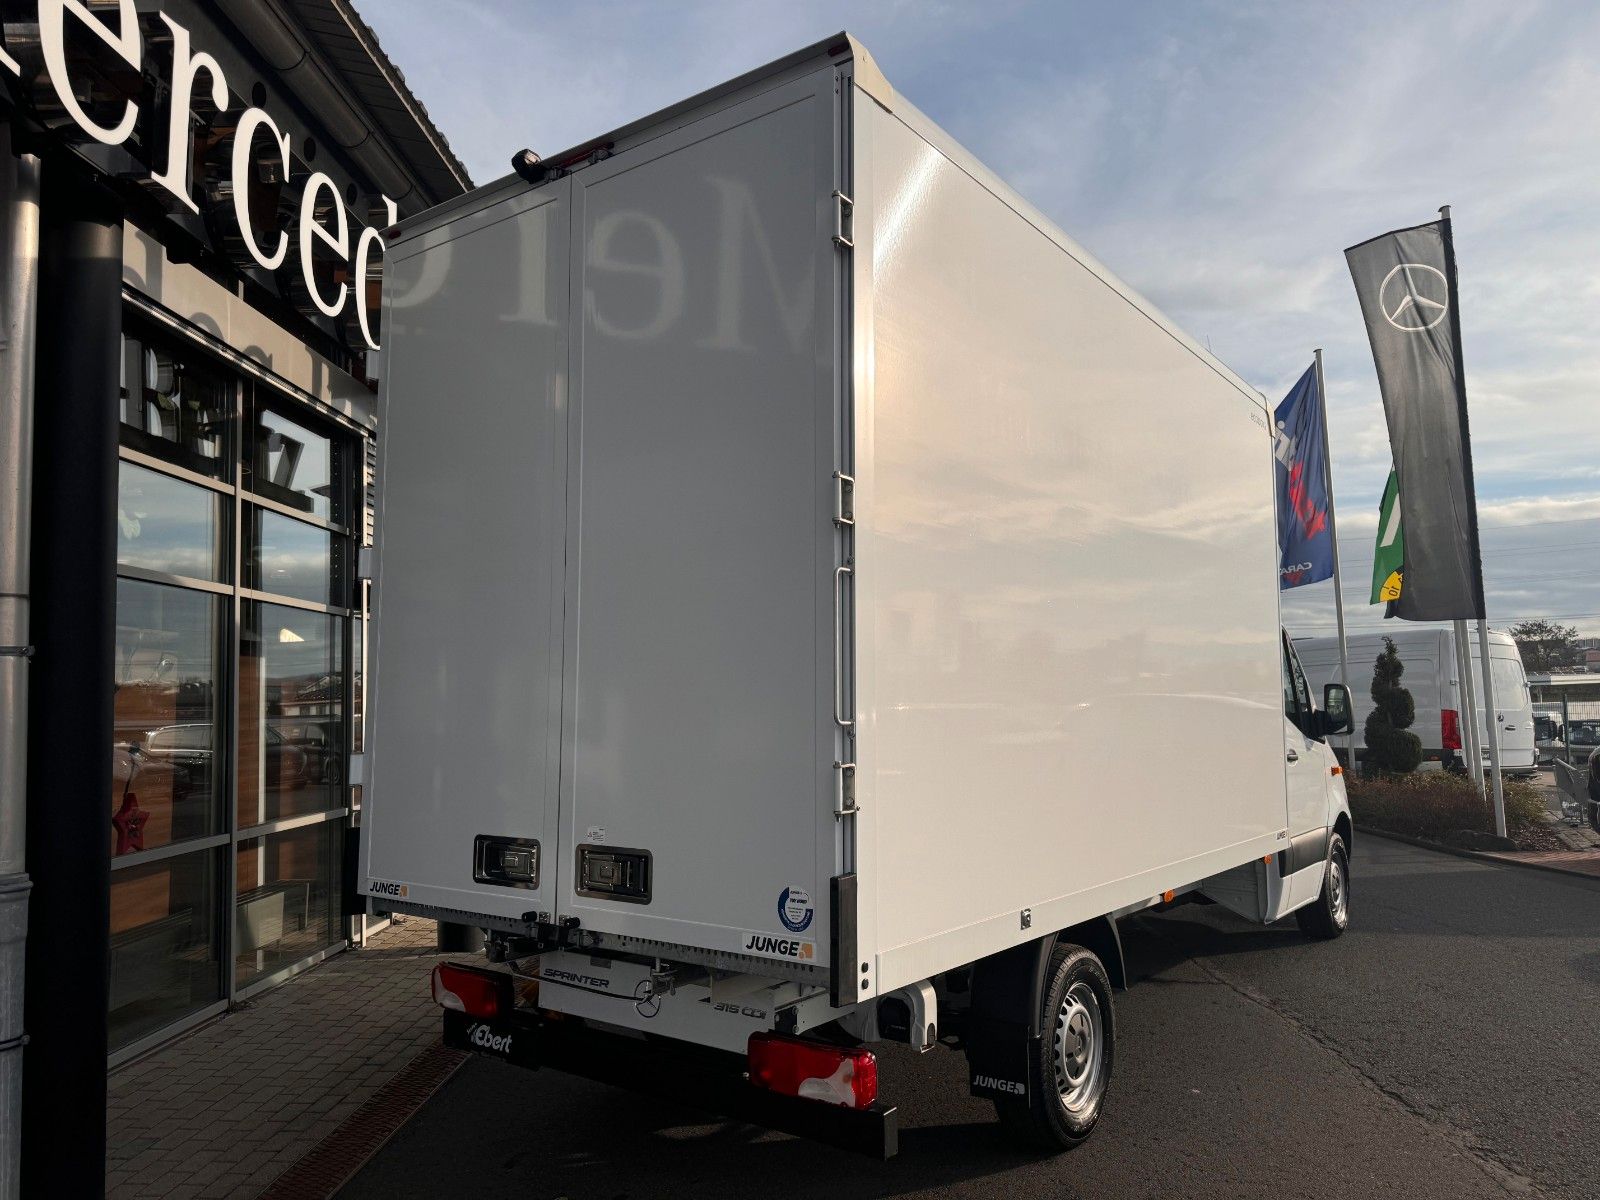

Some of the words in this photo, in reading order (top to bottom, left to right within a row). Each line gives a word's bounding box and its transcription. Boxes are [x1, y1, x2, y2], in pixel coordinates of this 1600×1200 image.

[0, 0, 397, 350] erced
[369, 881, 401, 896] JUNGE
[745, 935, 800, 957] JUNGE
[543, 968, 610, 988] SPRINTER
[713, 1002, 740, 1014] 315
[475, 1024, 513, 1054] Ebert
[973, 1074, 1015, 1093] JUNGE
